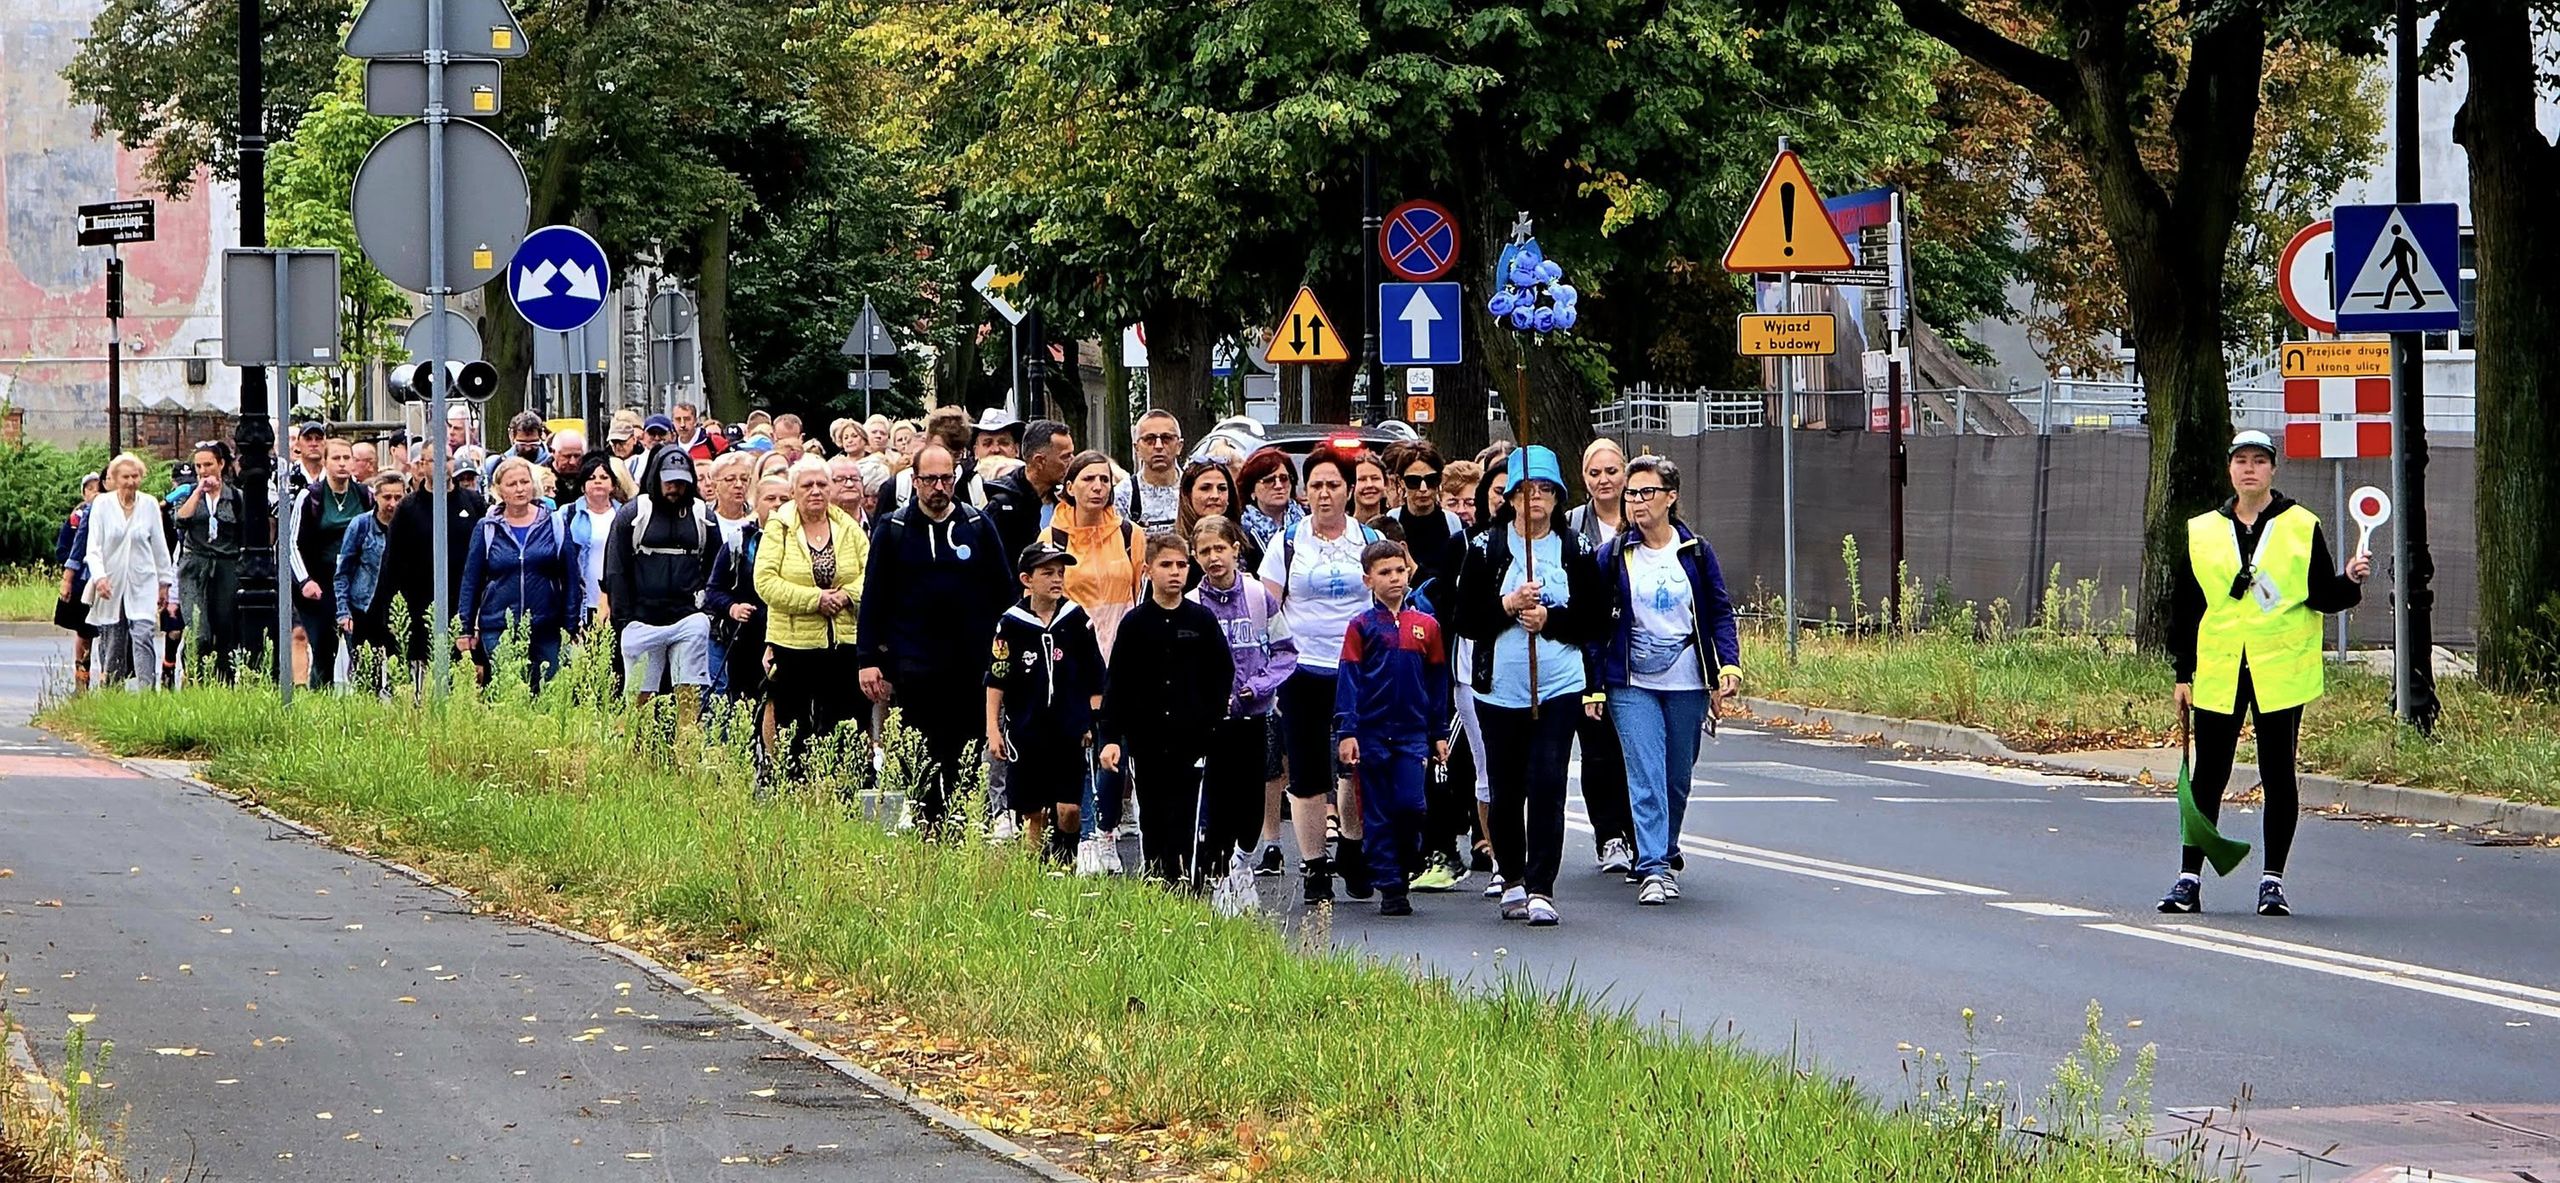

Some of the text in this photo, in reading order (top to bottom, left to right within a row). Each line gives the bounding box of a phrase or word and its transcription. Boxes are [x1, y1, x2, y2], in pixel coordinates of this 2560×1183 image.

[1764, 320, 1810, 335] Wyjazd
[1770, 338, 1820, 352] budowy
[2306, 346, 2351, 357] Przejście
[2356, 362, 2380, 372] ulicy
